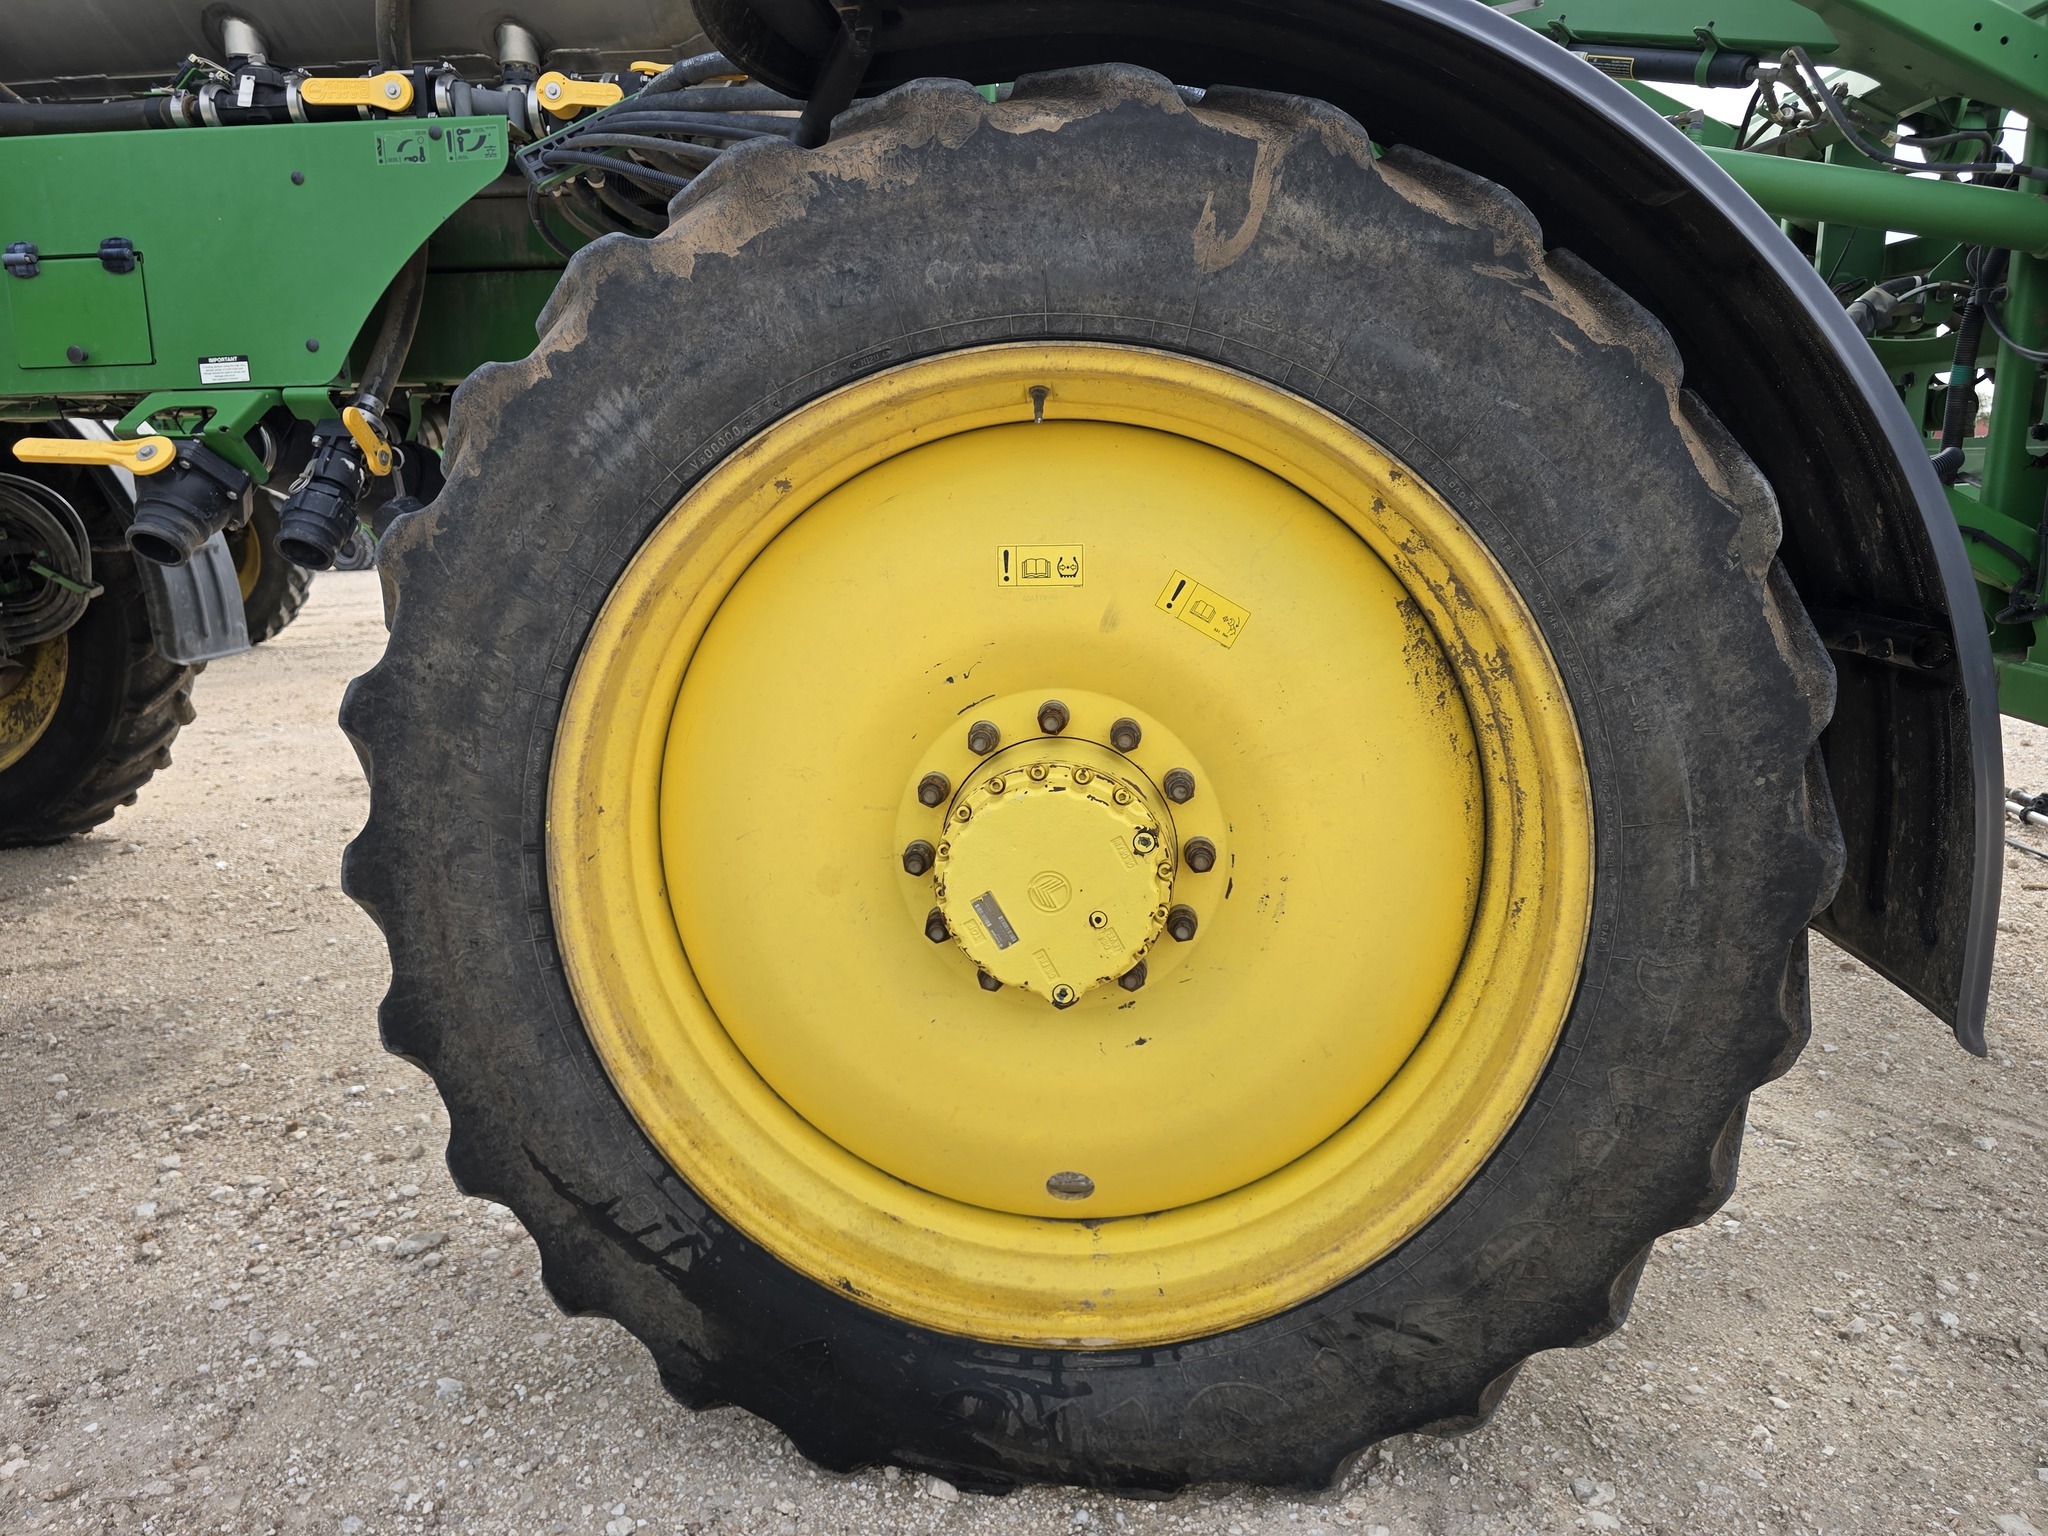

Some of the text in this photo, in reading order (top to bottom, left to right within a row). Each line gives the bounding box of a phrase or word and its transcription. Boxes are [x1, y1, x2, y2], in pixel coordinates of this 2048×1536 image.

[1441, 474, 1467, 500] LOAD
[1465, 499, 1480, 513] AT
[1496, 536, 1516, 558] MPH
[1598, 923, 1609, 944] BAR
[967, 922, 982, 941] TOP
